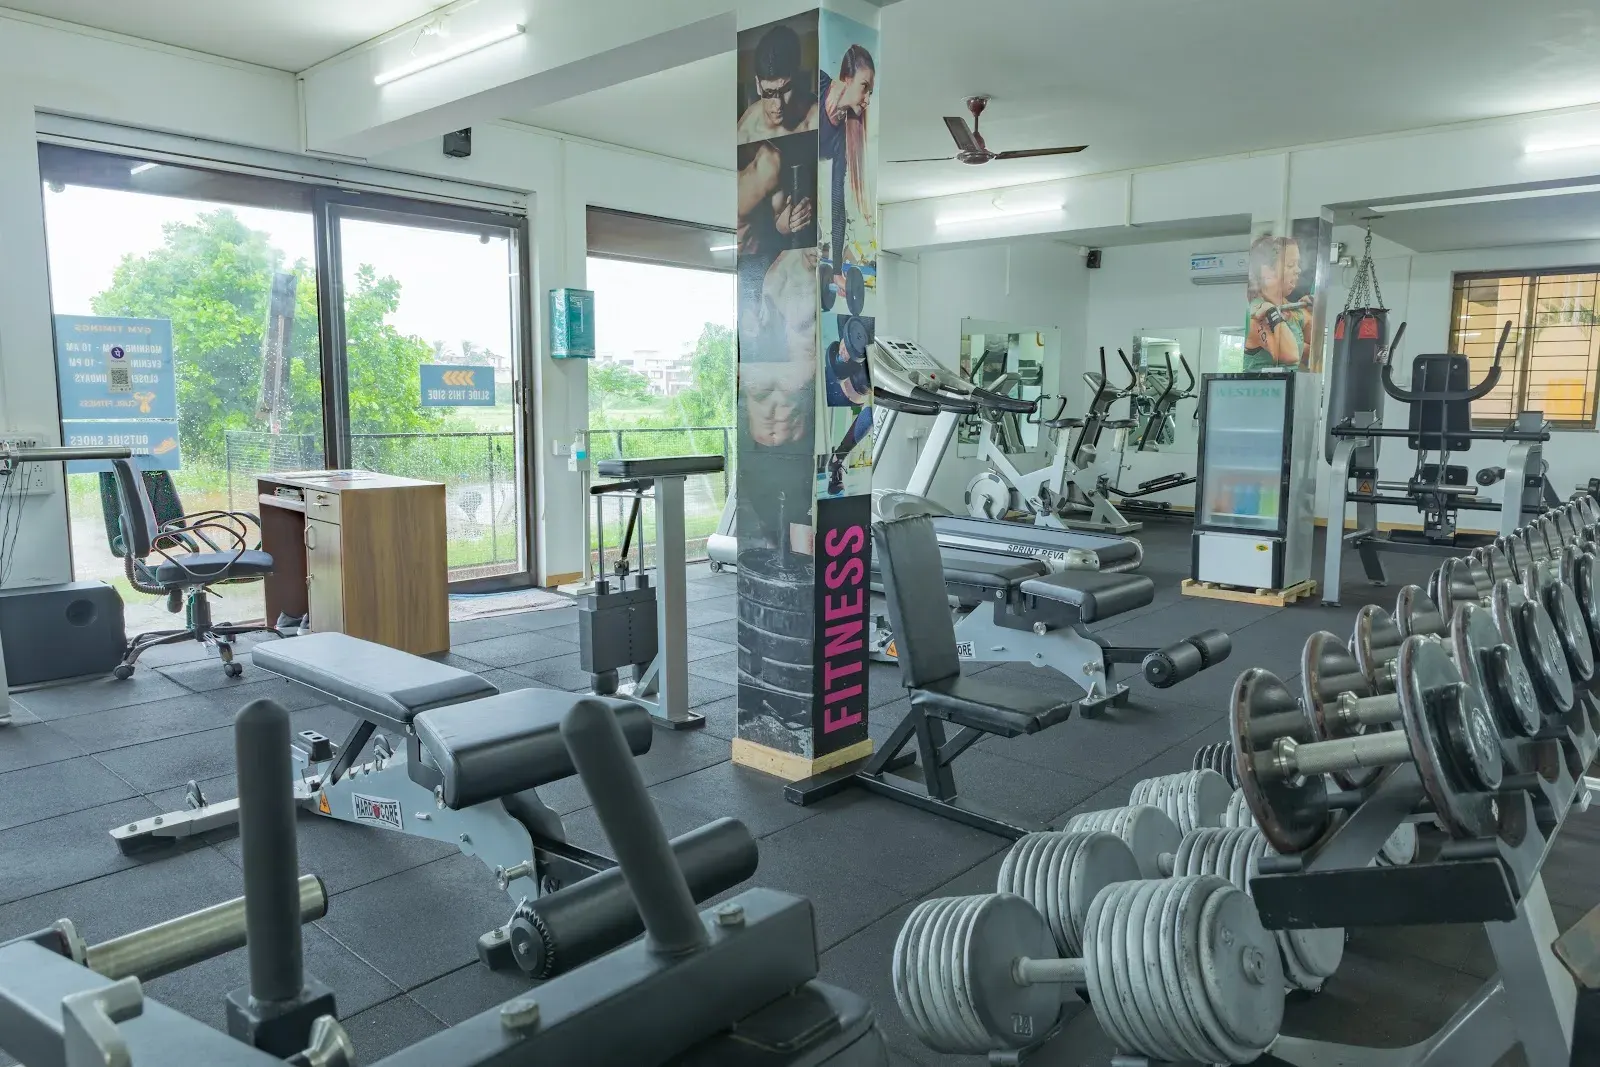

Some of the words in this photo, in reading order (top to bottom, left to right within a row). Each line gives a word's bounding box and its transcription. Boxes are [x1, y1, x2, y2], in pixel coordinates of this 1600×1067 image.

[1216, 386, 1282, 399] WESTERN
[1007, 544, 1040, 556] SPRINT
[1041, 549, 1065, 561] REVA
[824, 525, 865, 734] FITNESS
[956, 643, 973, 657] ORE
[354, 797, 373, 816] HARD
[380, 804, 399, 824] CORE
